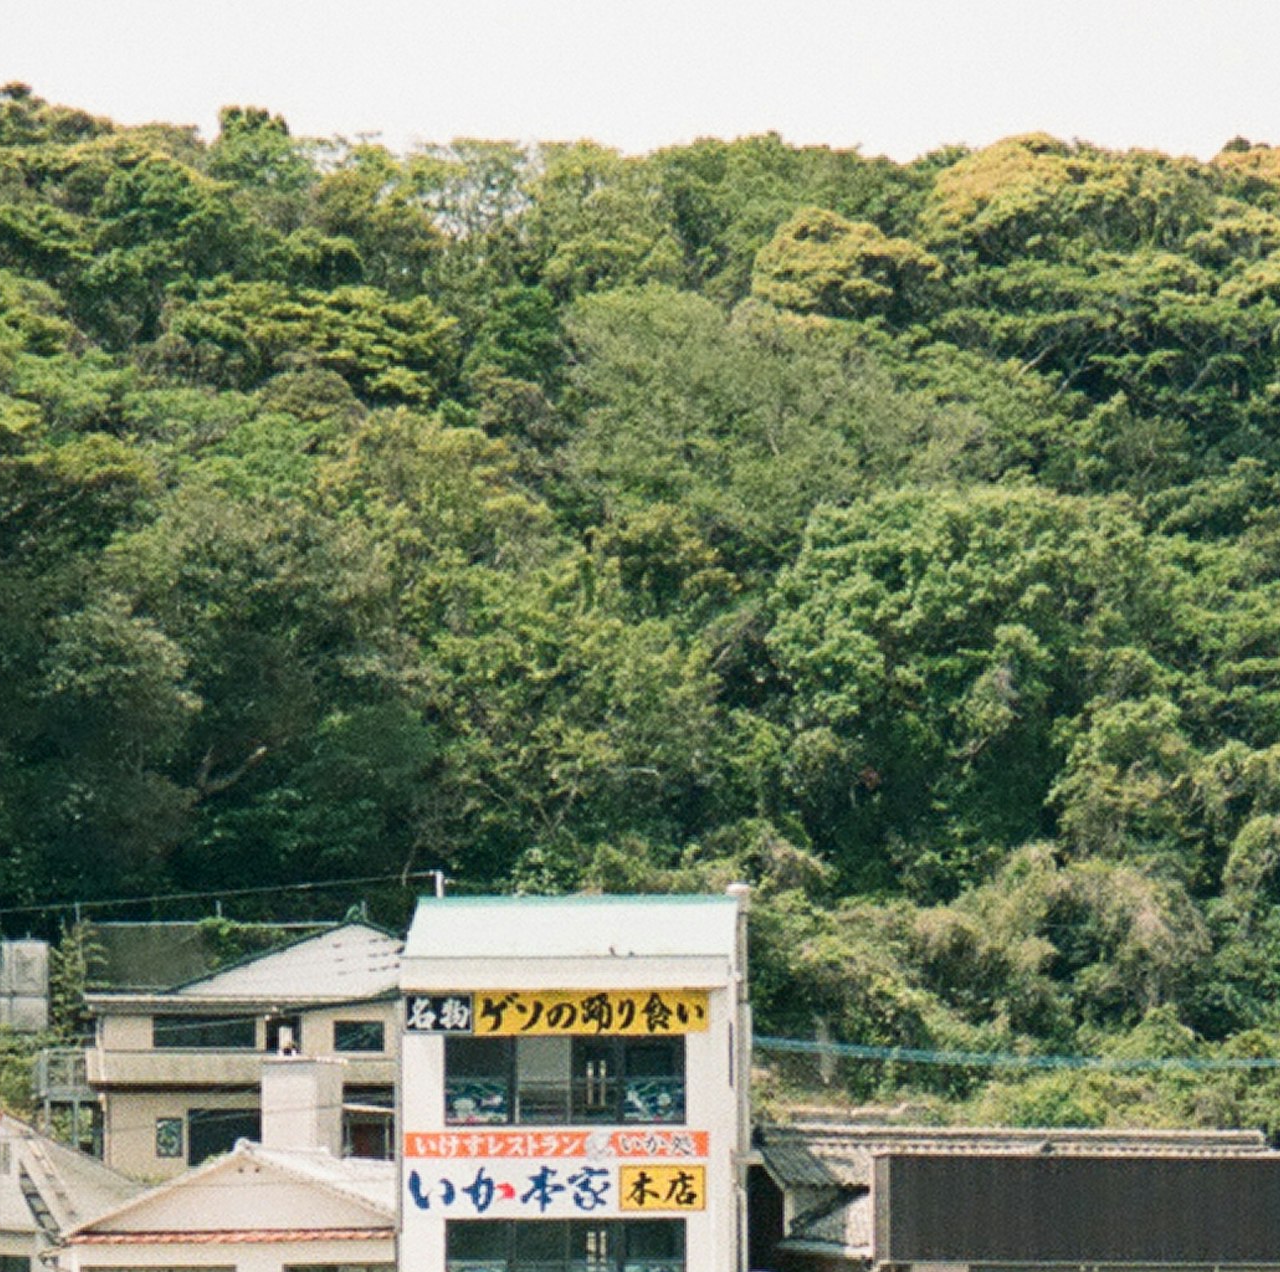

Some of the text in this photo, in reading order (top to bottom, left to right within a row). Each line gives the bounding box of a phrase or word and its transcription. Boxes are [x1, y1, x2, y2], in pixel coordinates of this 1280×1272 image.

[407, 992, 705, 1035] 名物 ゲソの踊り食い
[415, 1132, 697, 1157] いけすレストラン いか処
[408, 1166, 698, 1213] いか本家 本店
